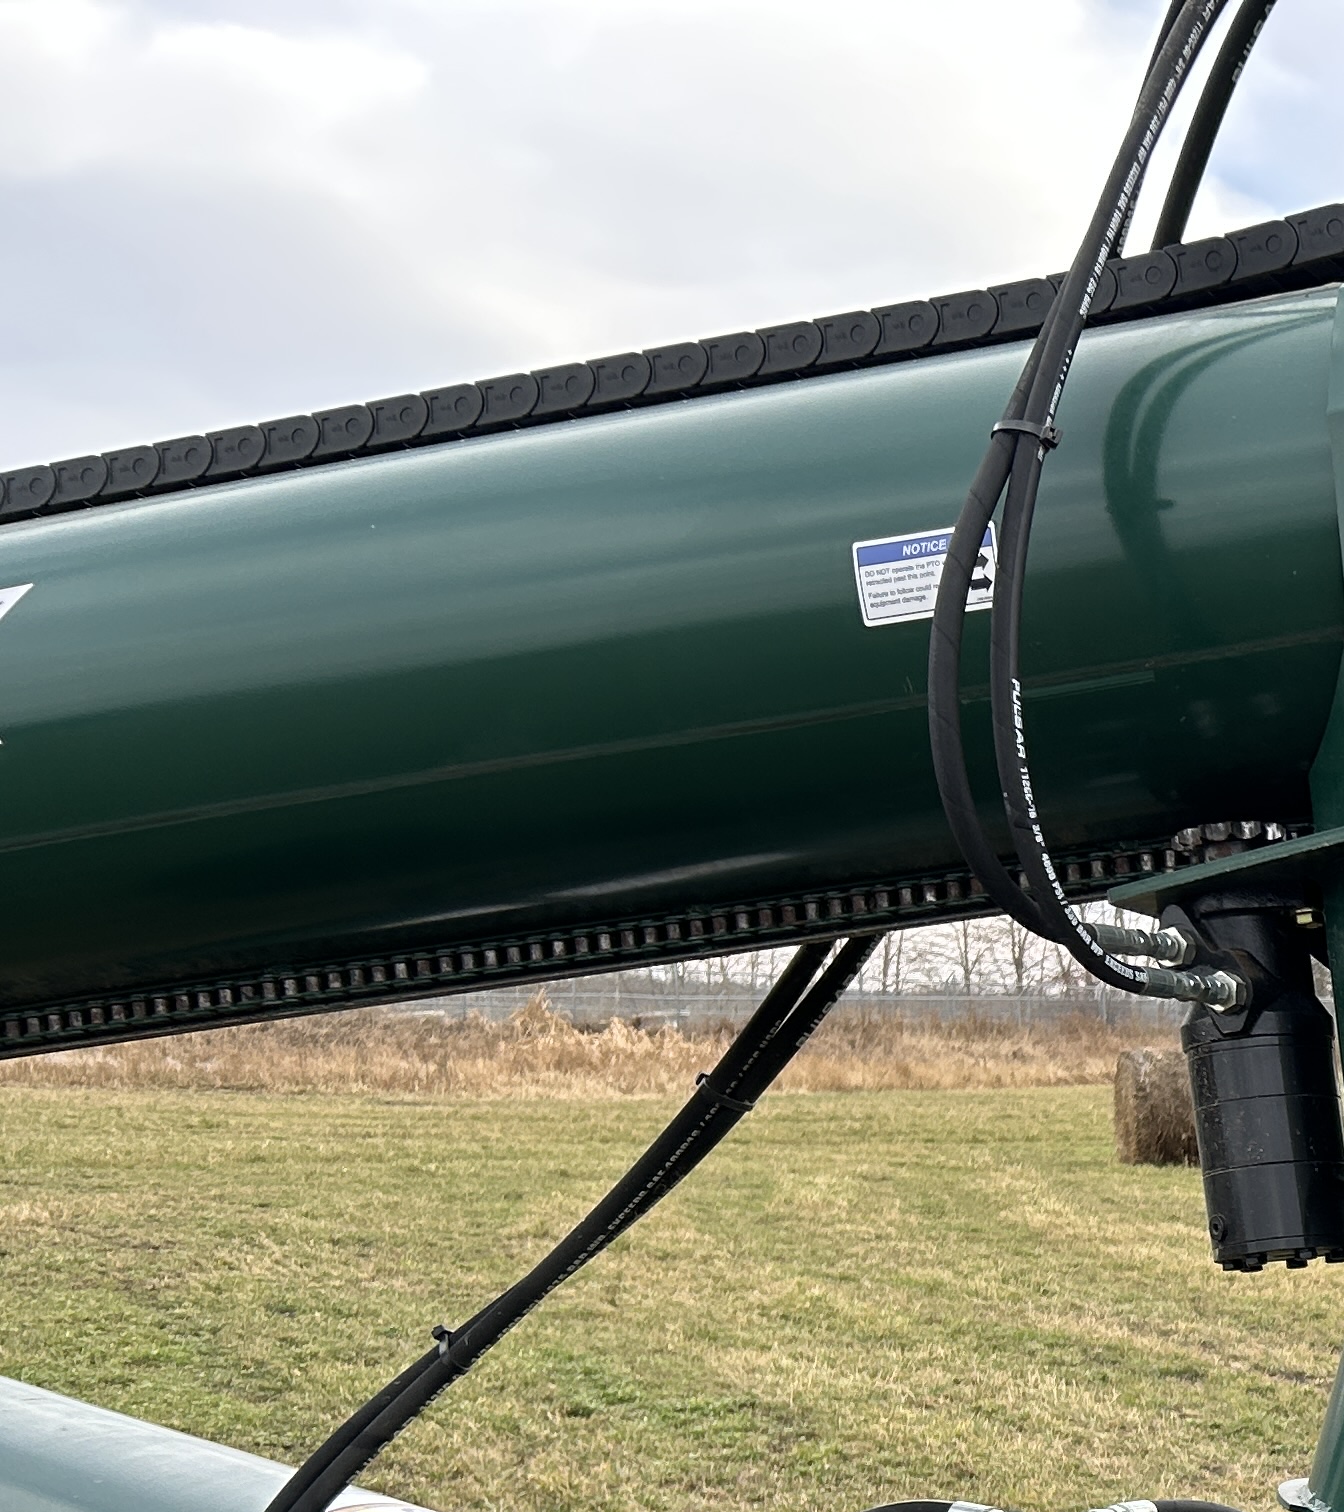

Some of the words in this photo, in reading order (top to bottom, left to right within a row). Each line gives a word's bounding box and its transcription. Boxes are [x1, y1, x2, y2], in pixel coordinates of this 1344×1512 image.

[902, 538, 947, 556] NOTICE
[926, 560, 939, 568] PTO
[1010, 677, 1026, 760] PULSAR
